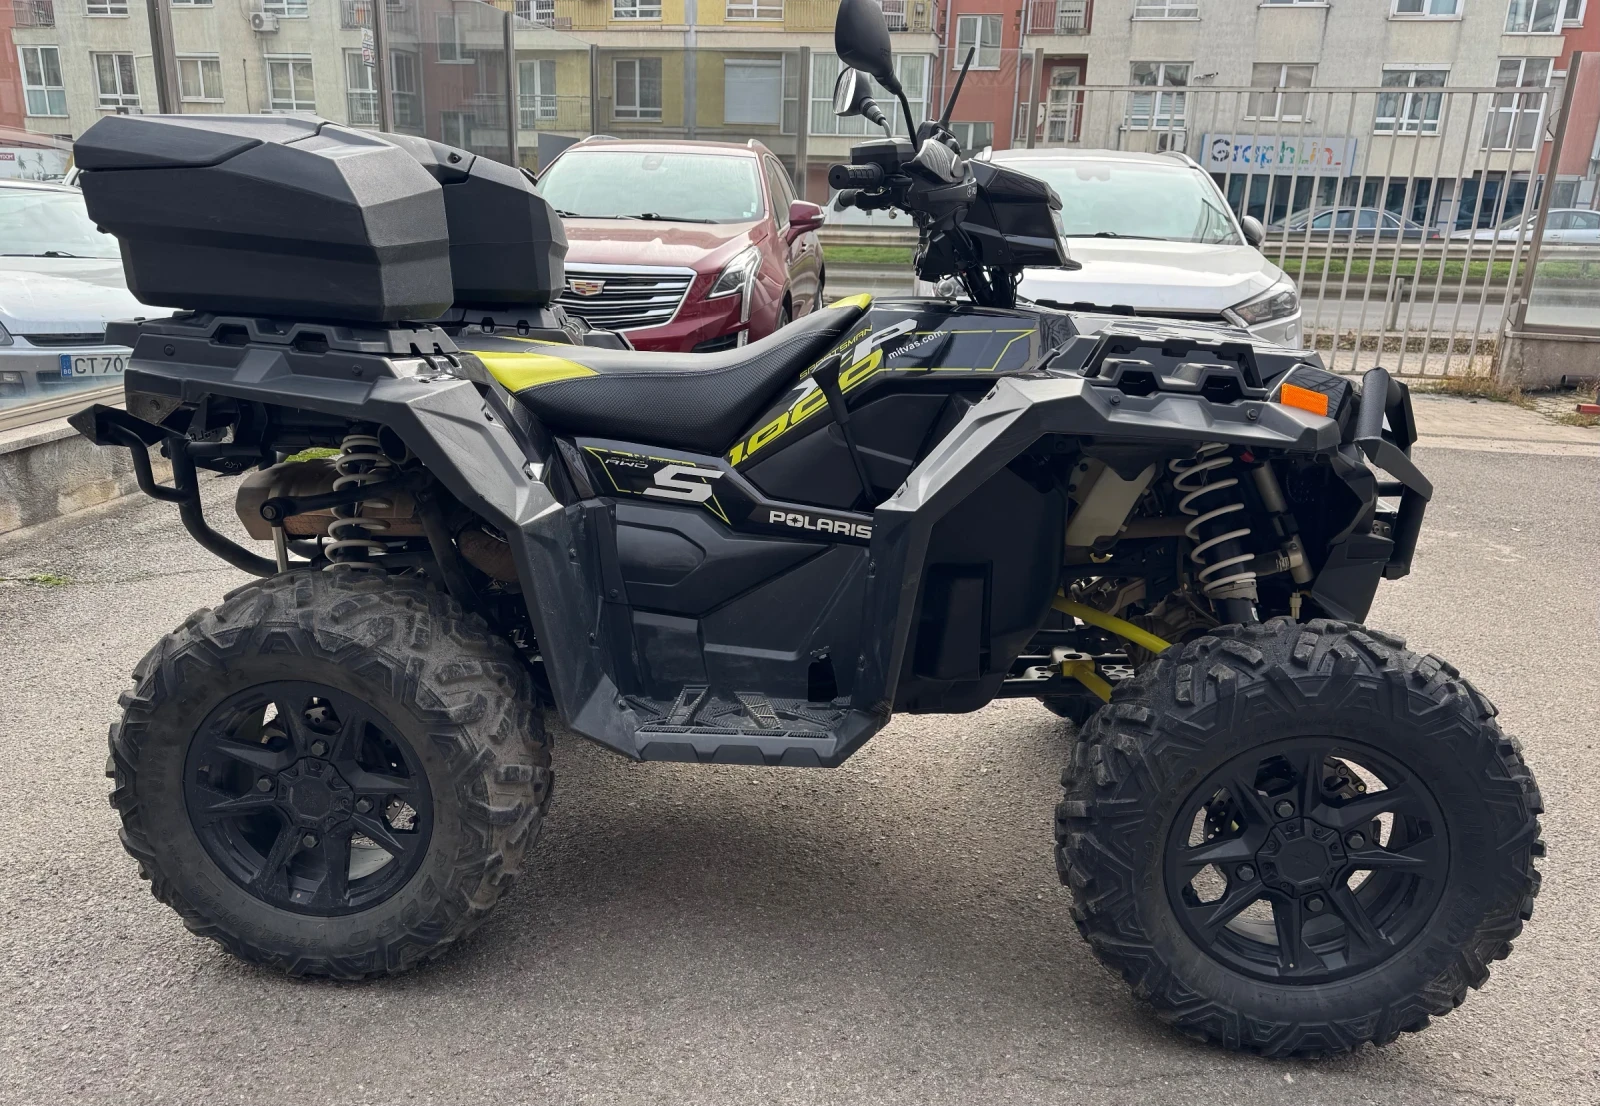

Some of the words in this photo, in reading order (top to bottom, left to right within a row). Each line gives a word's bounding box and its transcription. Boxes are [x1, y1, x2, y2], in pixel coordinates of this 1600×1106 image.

[888, 329, 944, 360] mitvas.com
[75, 357, 98, 374] CT
[102, 356, 130, 374] 70
[605, 458, 649, 469] AWD
[641, 464, 725, 503] S
[769, 510, 873, 539] POLARIS
